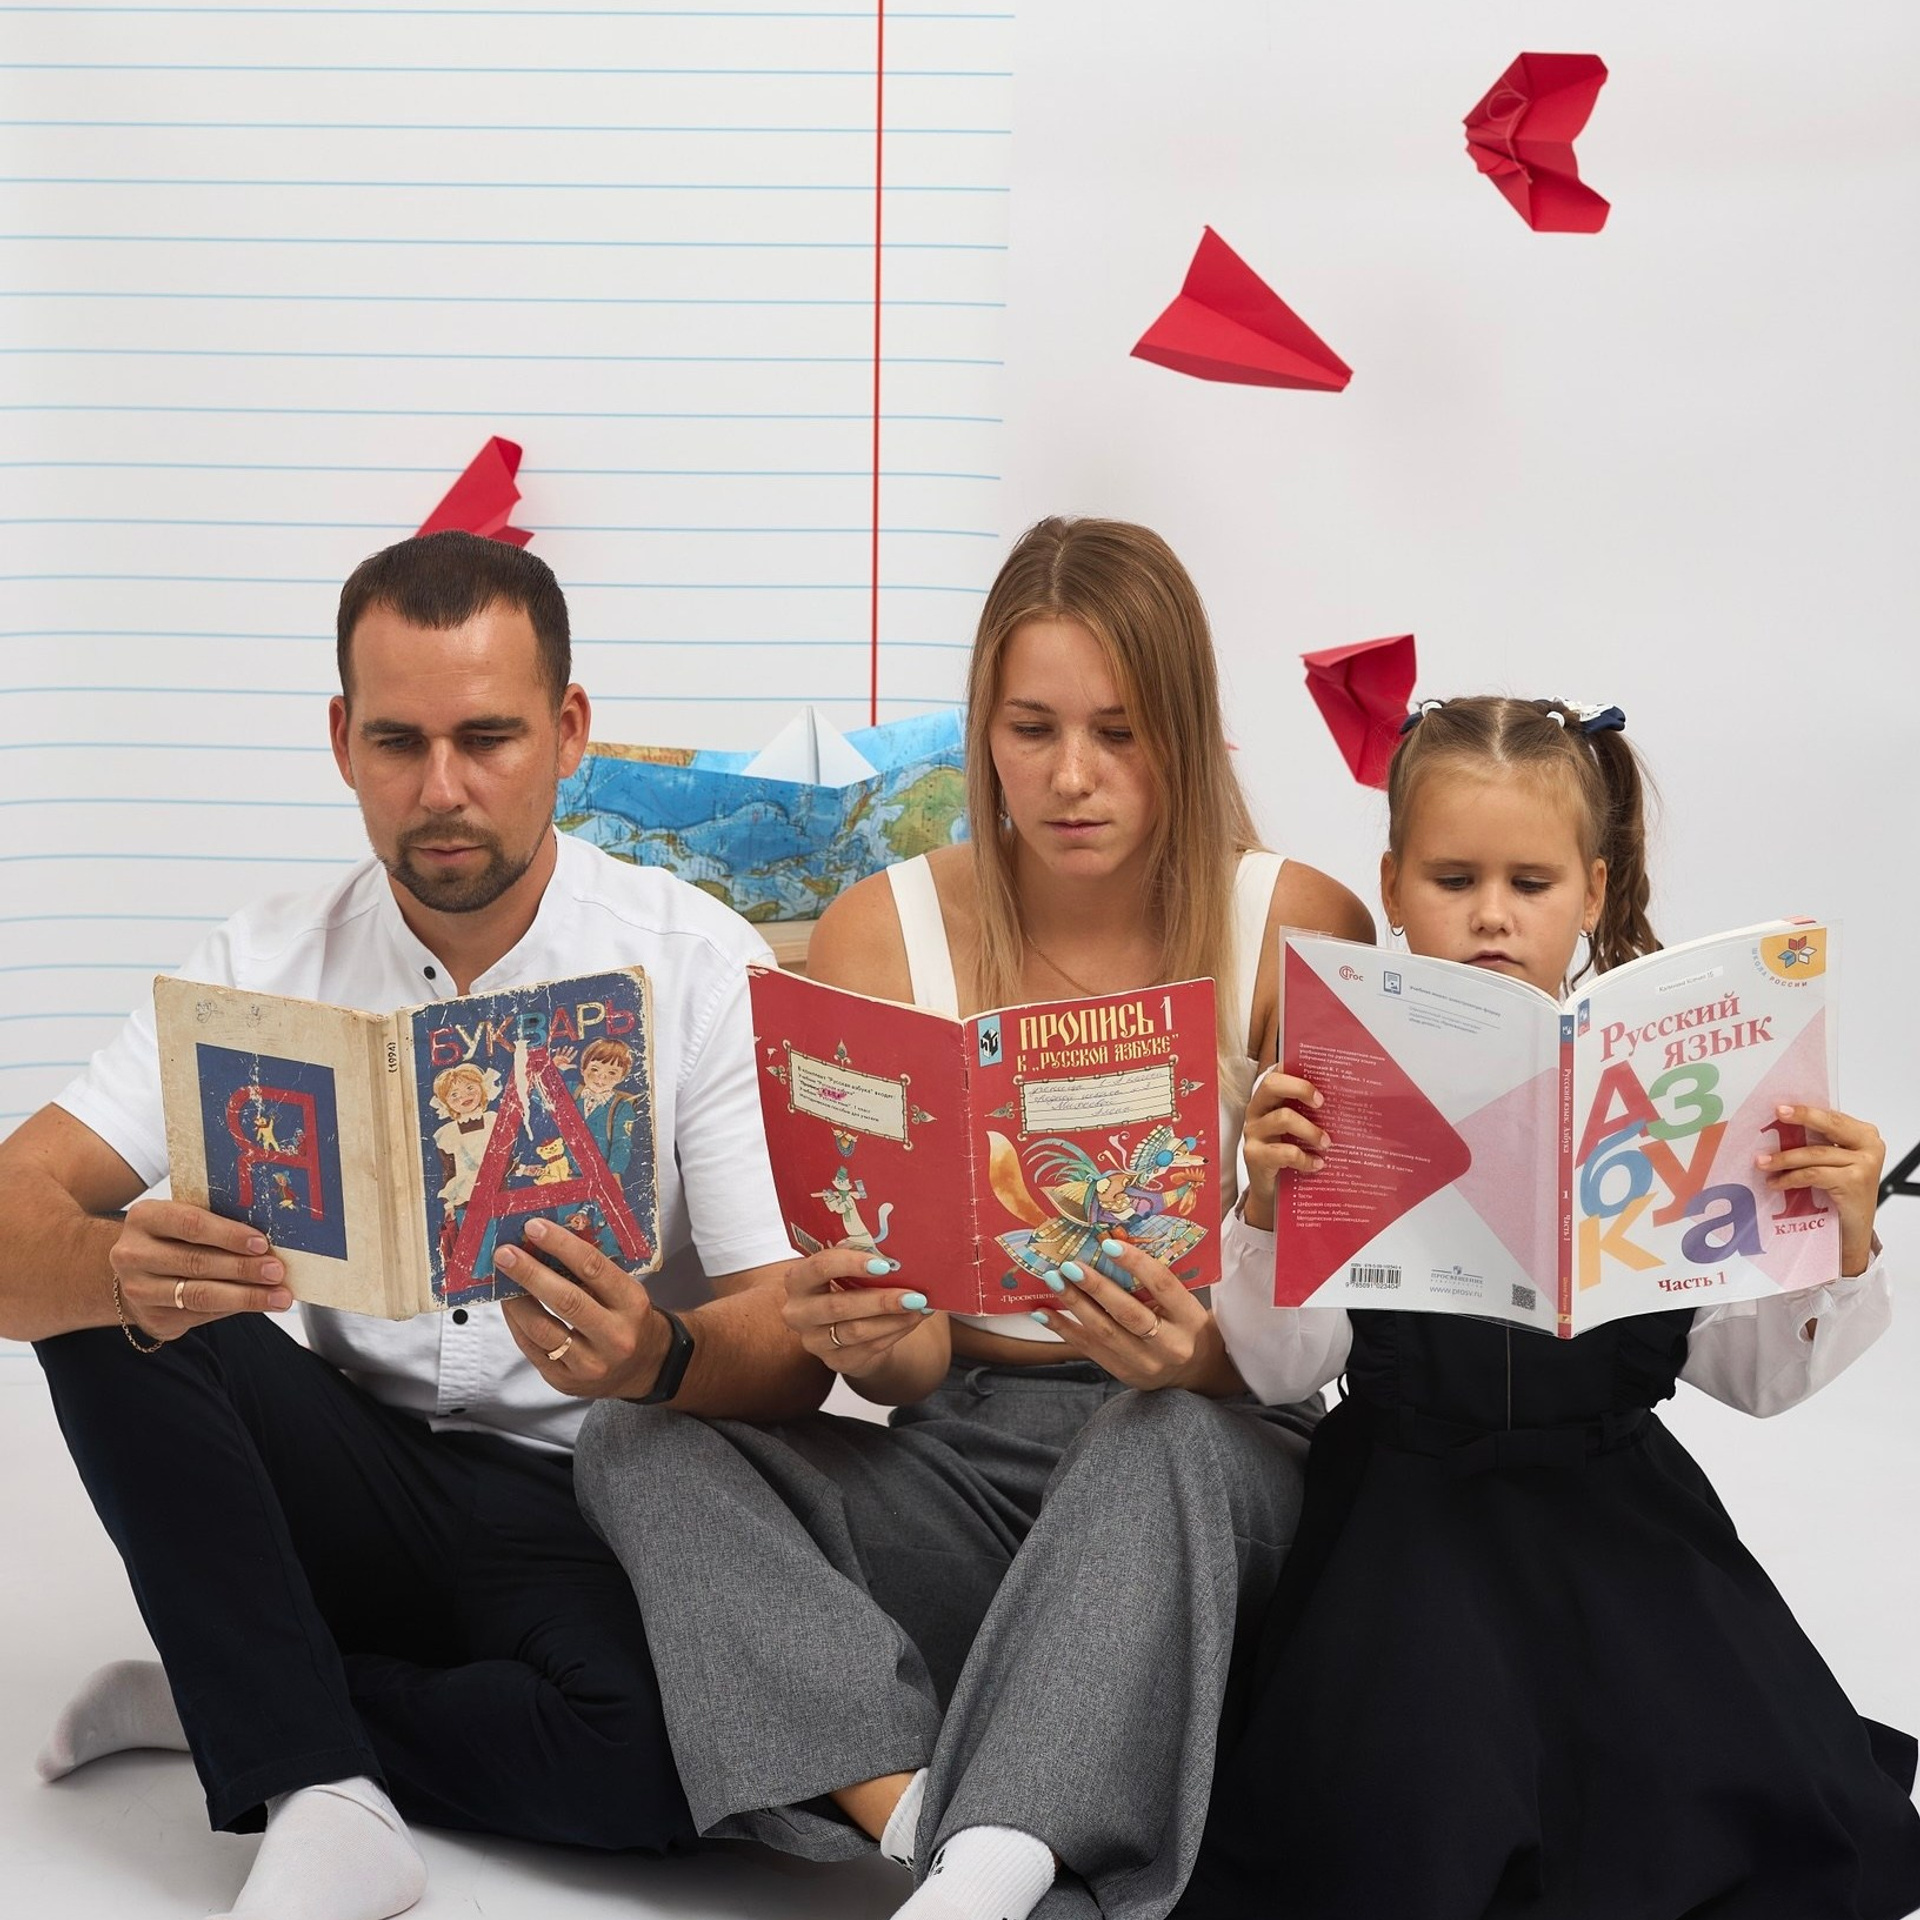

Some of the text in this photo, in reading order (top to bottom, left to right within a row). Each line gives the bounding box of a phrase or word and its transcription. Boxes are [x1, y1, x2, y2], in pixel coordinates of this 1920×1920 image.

[1770, 976, 1808, 988] РОССИИ
[429, 999, 636, 1068] БУКВАРЬ
[1020, 996, 1172, 1051] ПРОПИСЬ 1
[1600, 991, 1740, 1061] Русский
[386, 1042, 398, 1074] (1994)
[1663, 1016, 1774, 1069] язык
[1016, 1054, 1027, 1073] К
[1562, 1068, 1572, 1101] Русский
[226, 1086, 324, 1222] Я
[1562, 1126, 1572, 1153] Азбука
[440, 1046, 653, 1296] А
[1760, 1117, 1828, 1221] 1
[1563, 1214, 1572, 1236] Часть
[1774, 1215, 1826, 1236] класс
[1657, 1271, 1728, 1294] Часть 1
